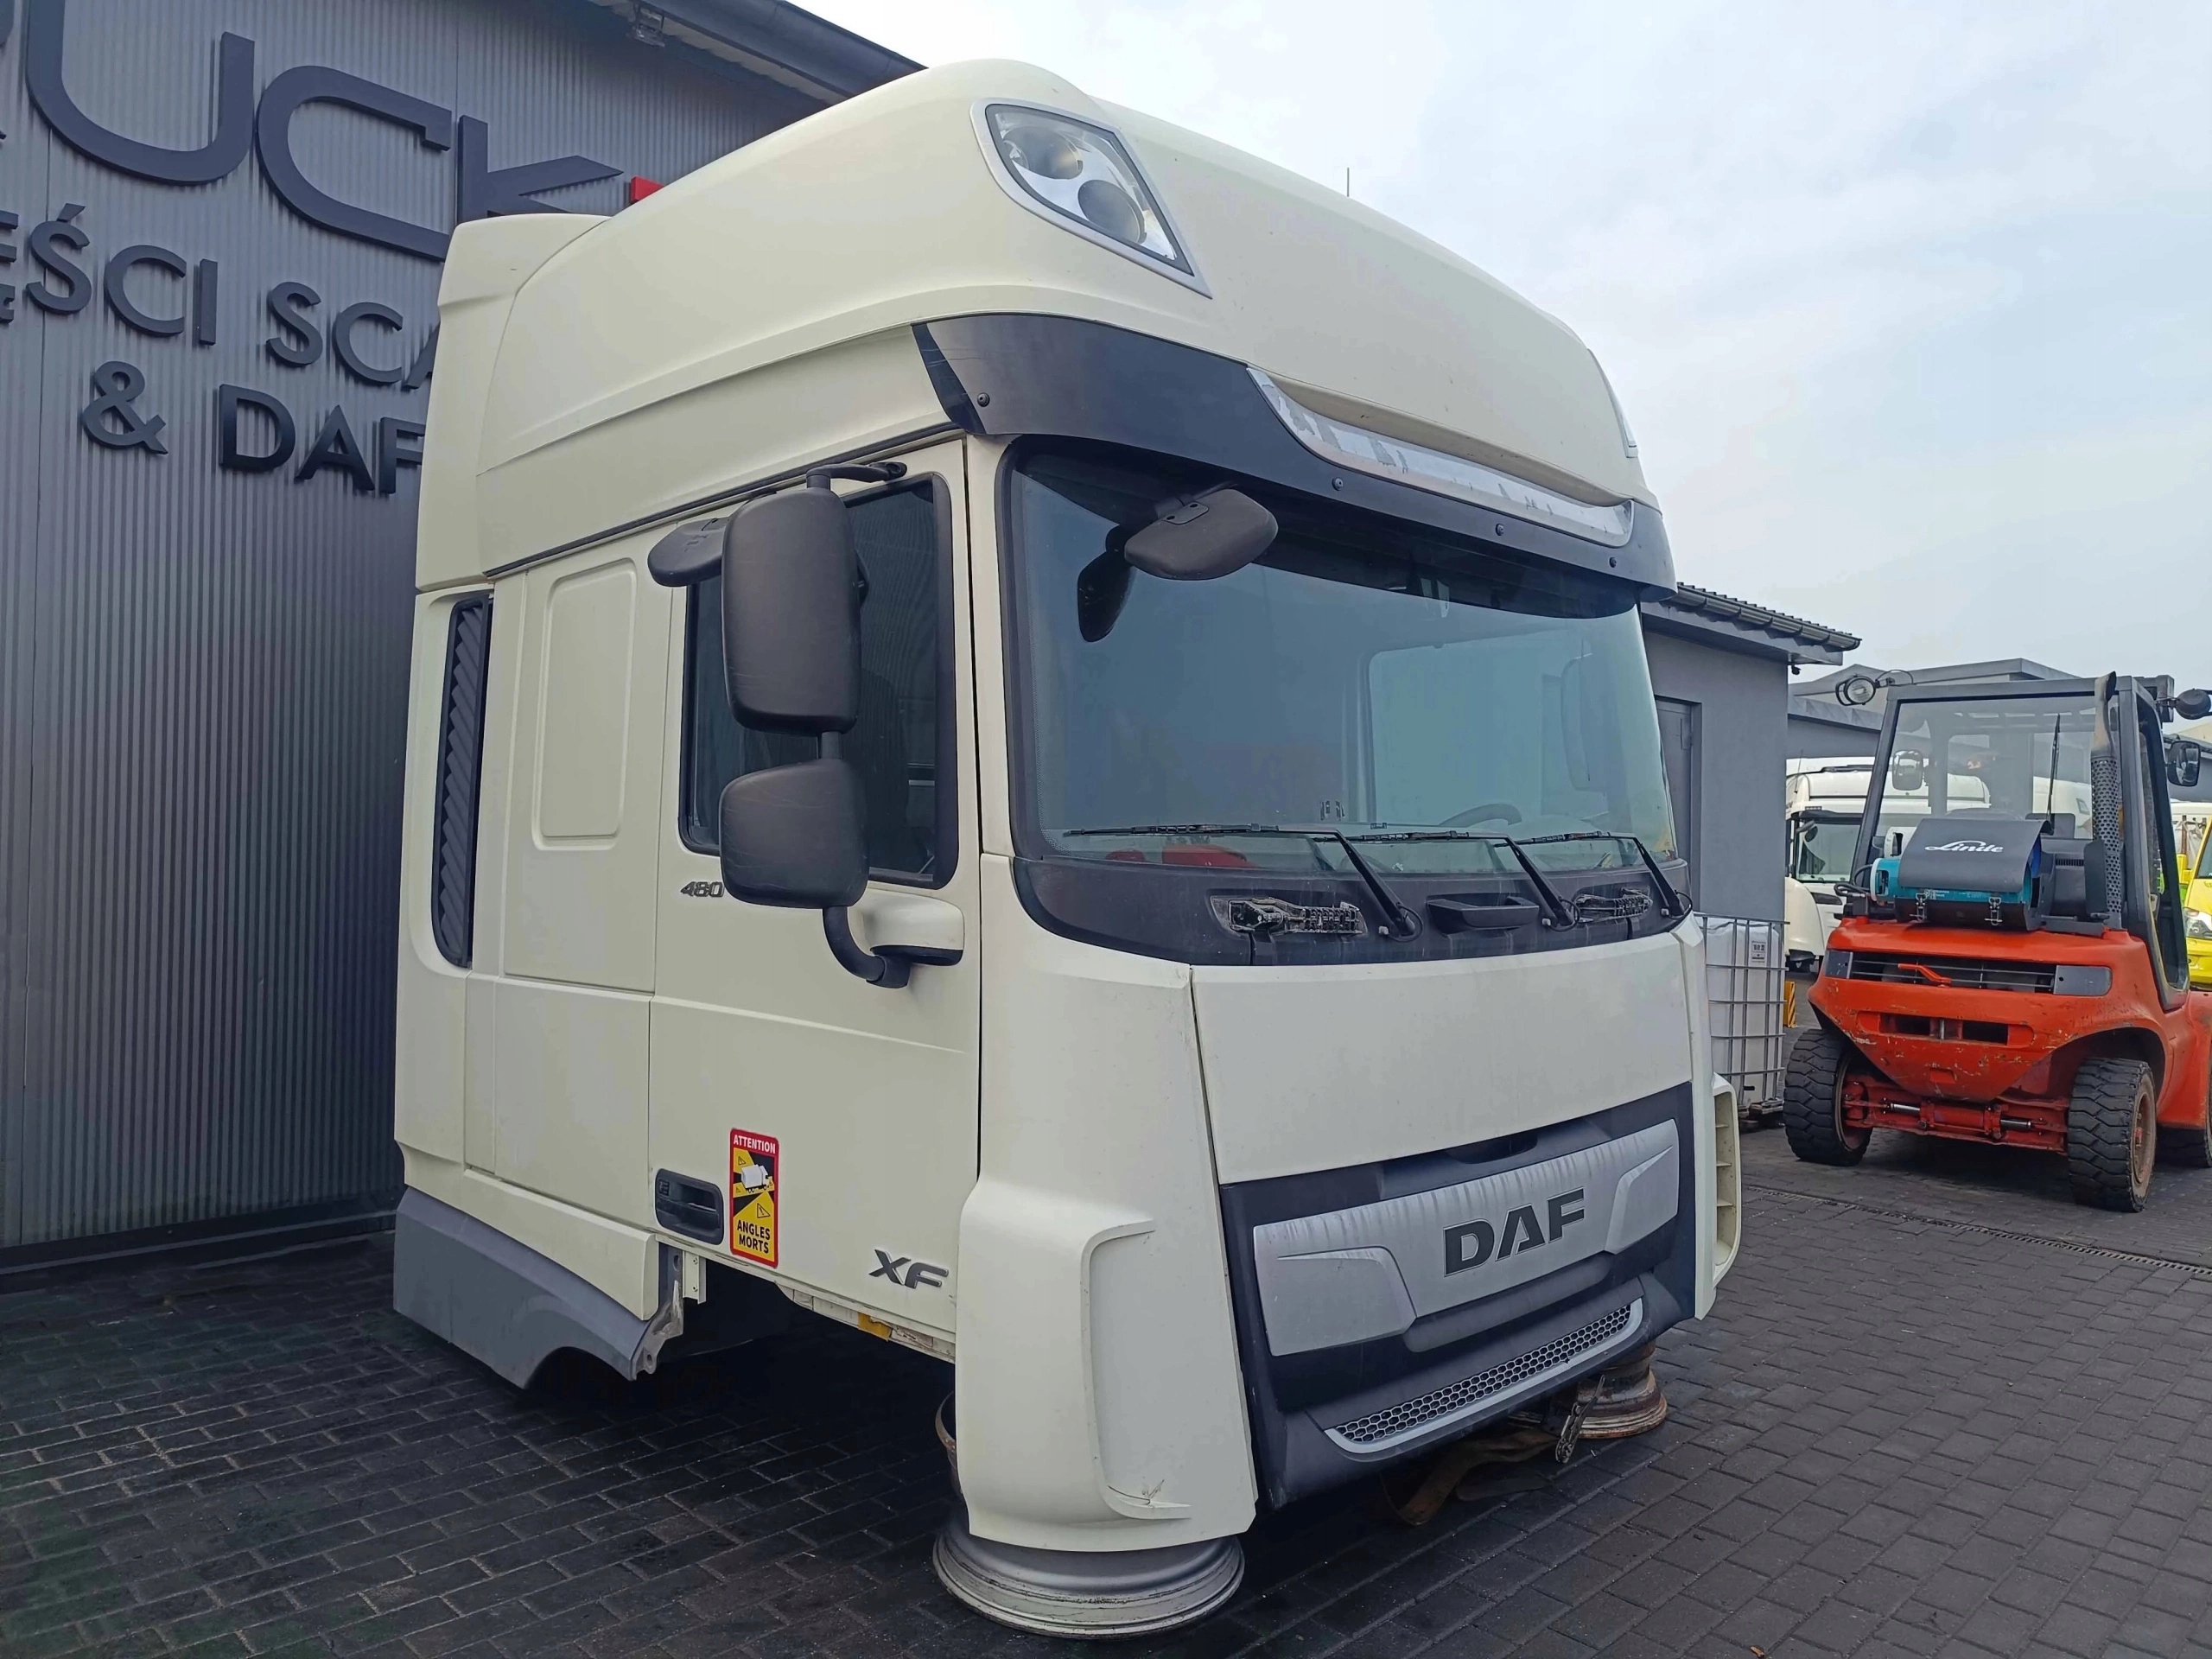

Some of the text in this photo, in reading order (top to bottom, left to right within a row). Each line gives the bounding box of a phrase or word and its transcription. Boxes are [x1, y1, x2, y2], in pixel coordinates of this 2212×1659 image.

[0, 0, 624, 263] UCK
[82, 360, 426, 494] & DAF
[1925, 840, 2004, 853] Linde
[680, 881, 725, 898] 480
[734, 1134, 776, 1154] ATTENTION
[736, 1219, 771, 1241] ANGLES
[1443, 1186, 1585, 1277] DAF
[739, 1234, 769, 1254] MORTS
[868, 1249, 950, 1289] XF
